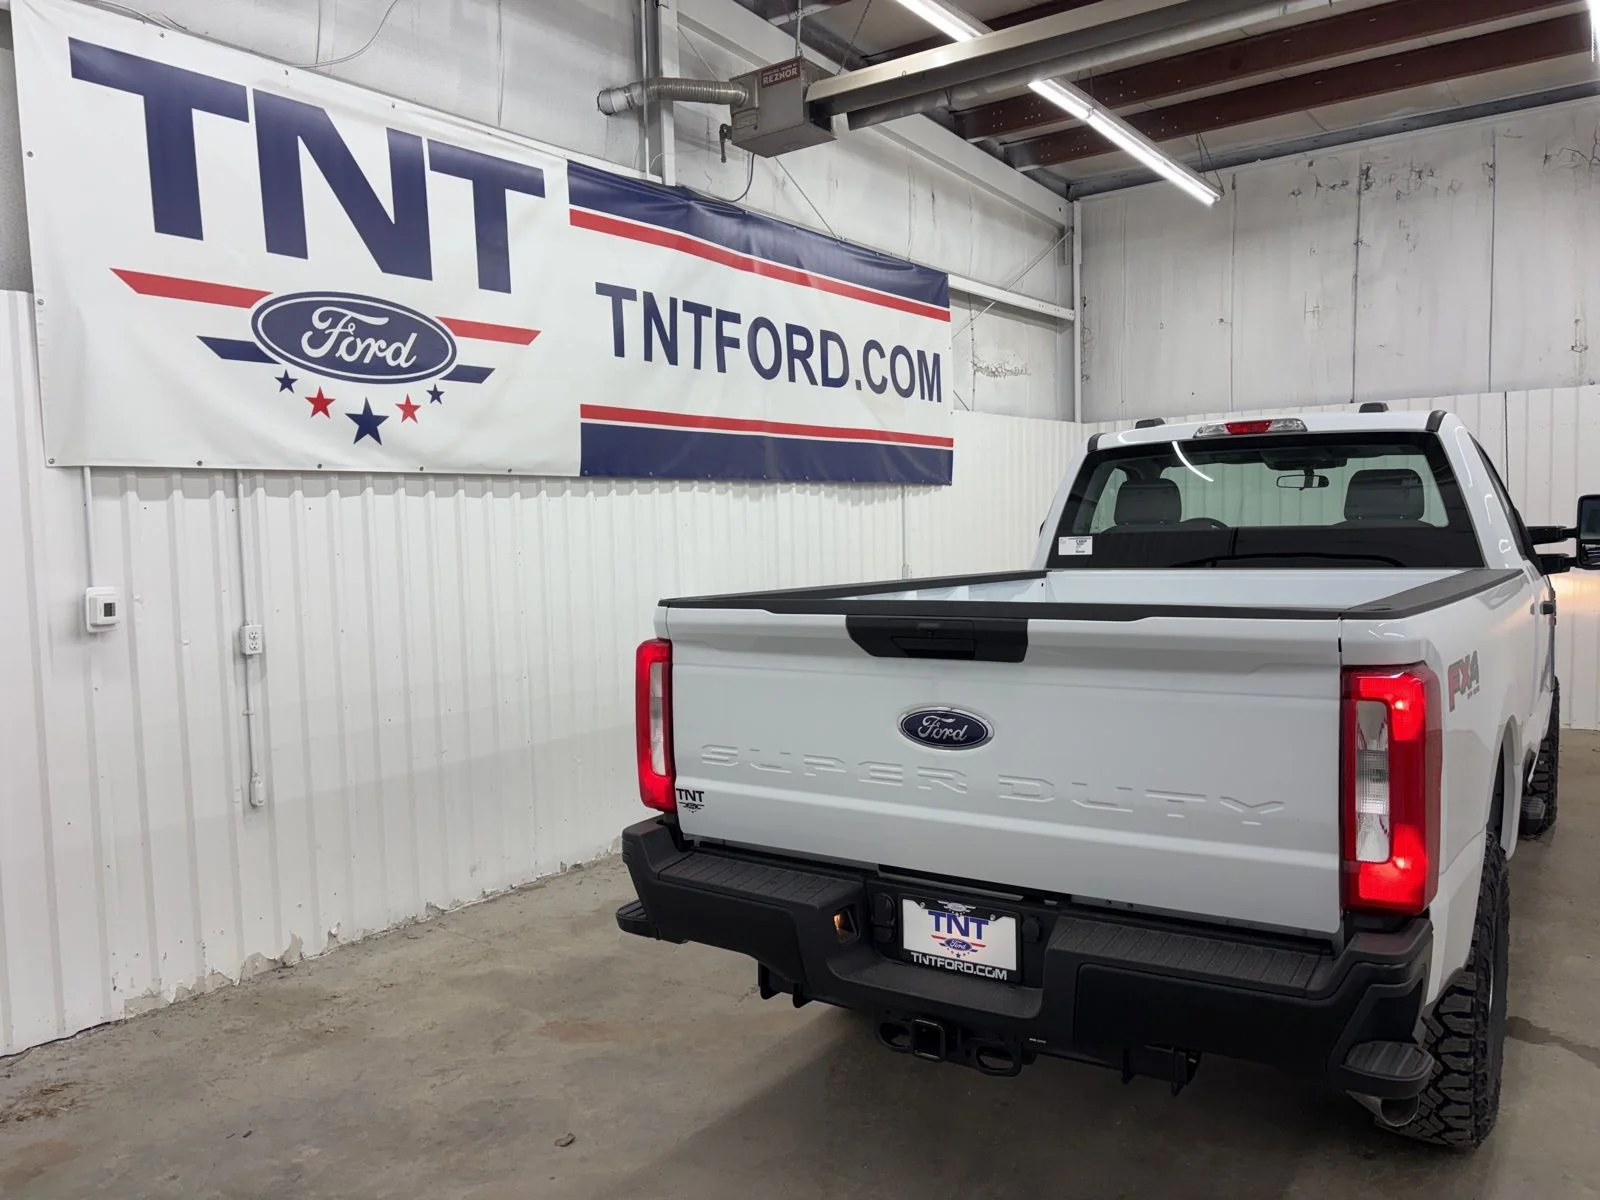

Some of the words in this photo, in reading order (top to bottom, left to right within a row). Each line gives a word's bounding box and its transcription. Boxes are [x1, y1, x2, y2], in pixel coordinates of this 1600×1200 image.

[763, 67, 797, 84] REZNOR
[68, 36, 546, 295] TNT
[300, 306, 417, 370] Ford
[595, 282, 942, 403] TNTFORD.COM
[1447, 649, 1480, 713] FX4
[917, 715, 969, 741] Ford
[675, 787, 705, 803] TNT
[701, 743, 968, 795] SUPER
[997, 773, 1285, 826] DUTY
[928, 910, 989, 940] TNT
[949, 940, 967, 950] Ford
[911, 952, 1007, 980] TNTFORD.COM
